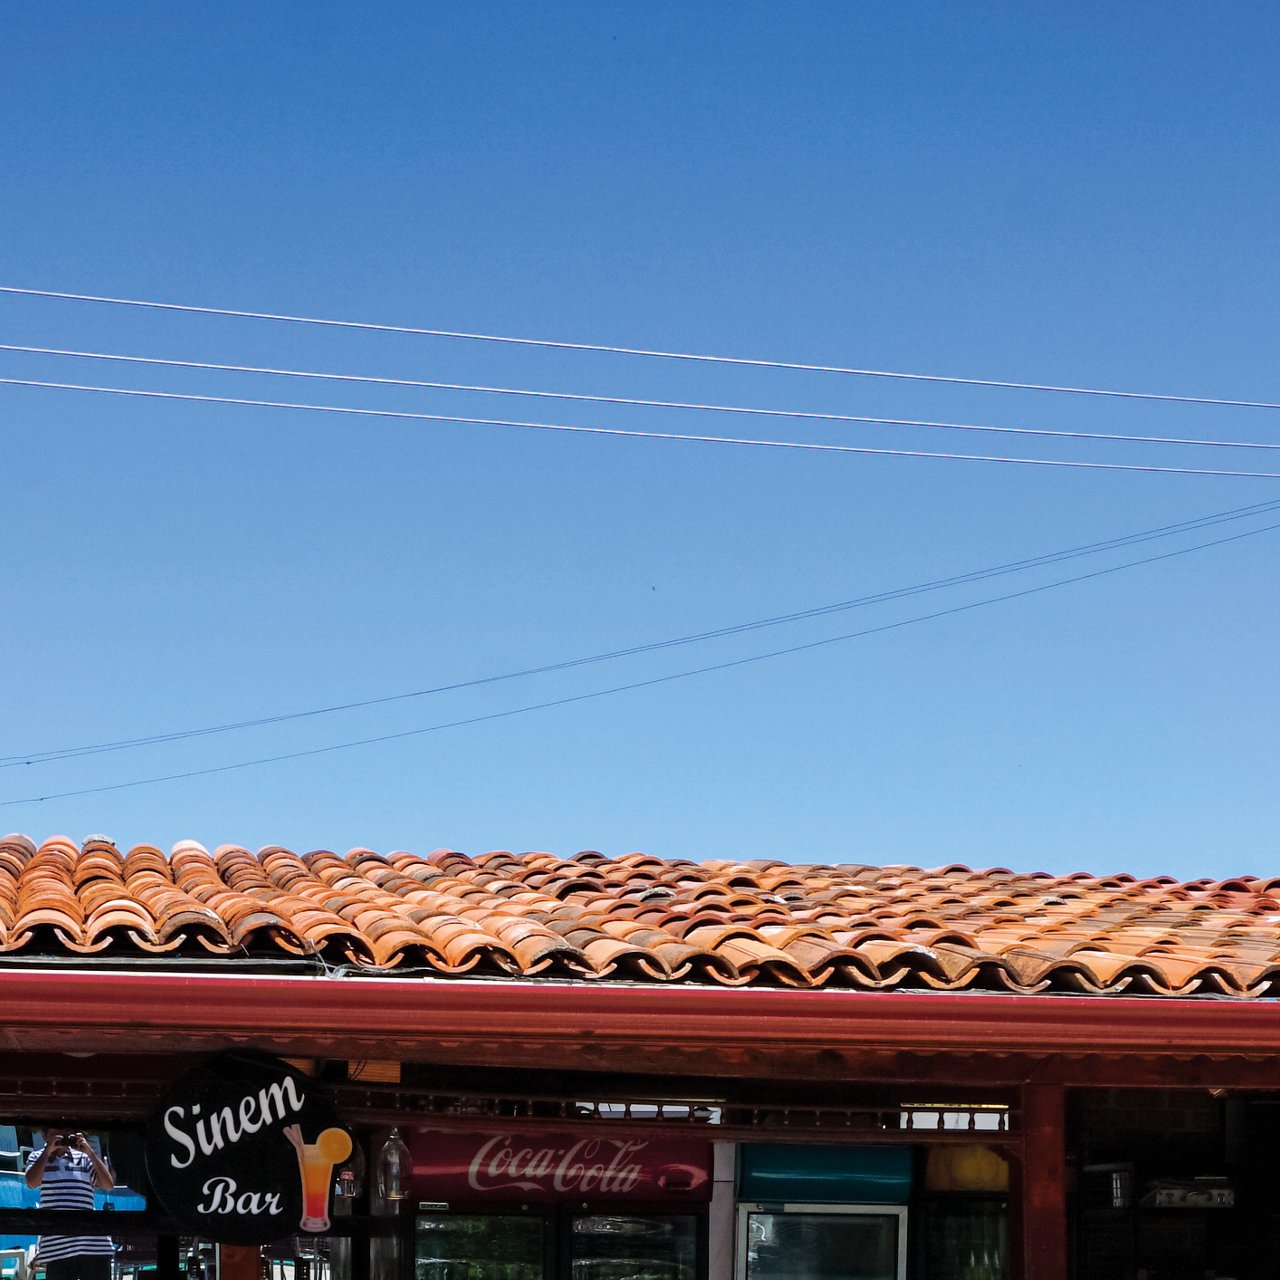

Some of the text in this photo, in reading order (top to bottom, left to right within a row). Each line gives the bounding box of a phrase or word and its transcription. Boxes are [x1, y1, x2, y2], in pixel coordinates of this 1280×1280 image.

[164, 1076, 305, 1169] Sinem
[468, 1135, 649, 1193] Coca-Cola
[197, 1176, 284, 1216] Bar
